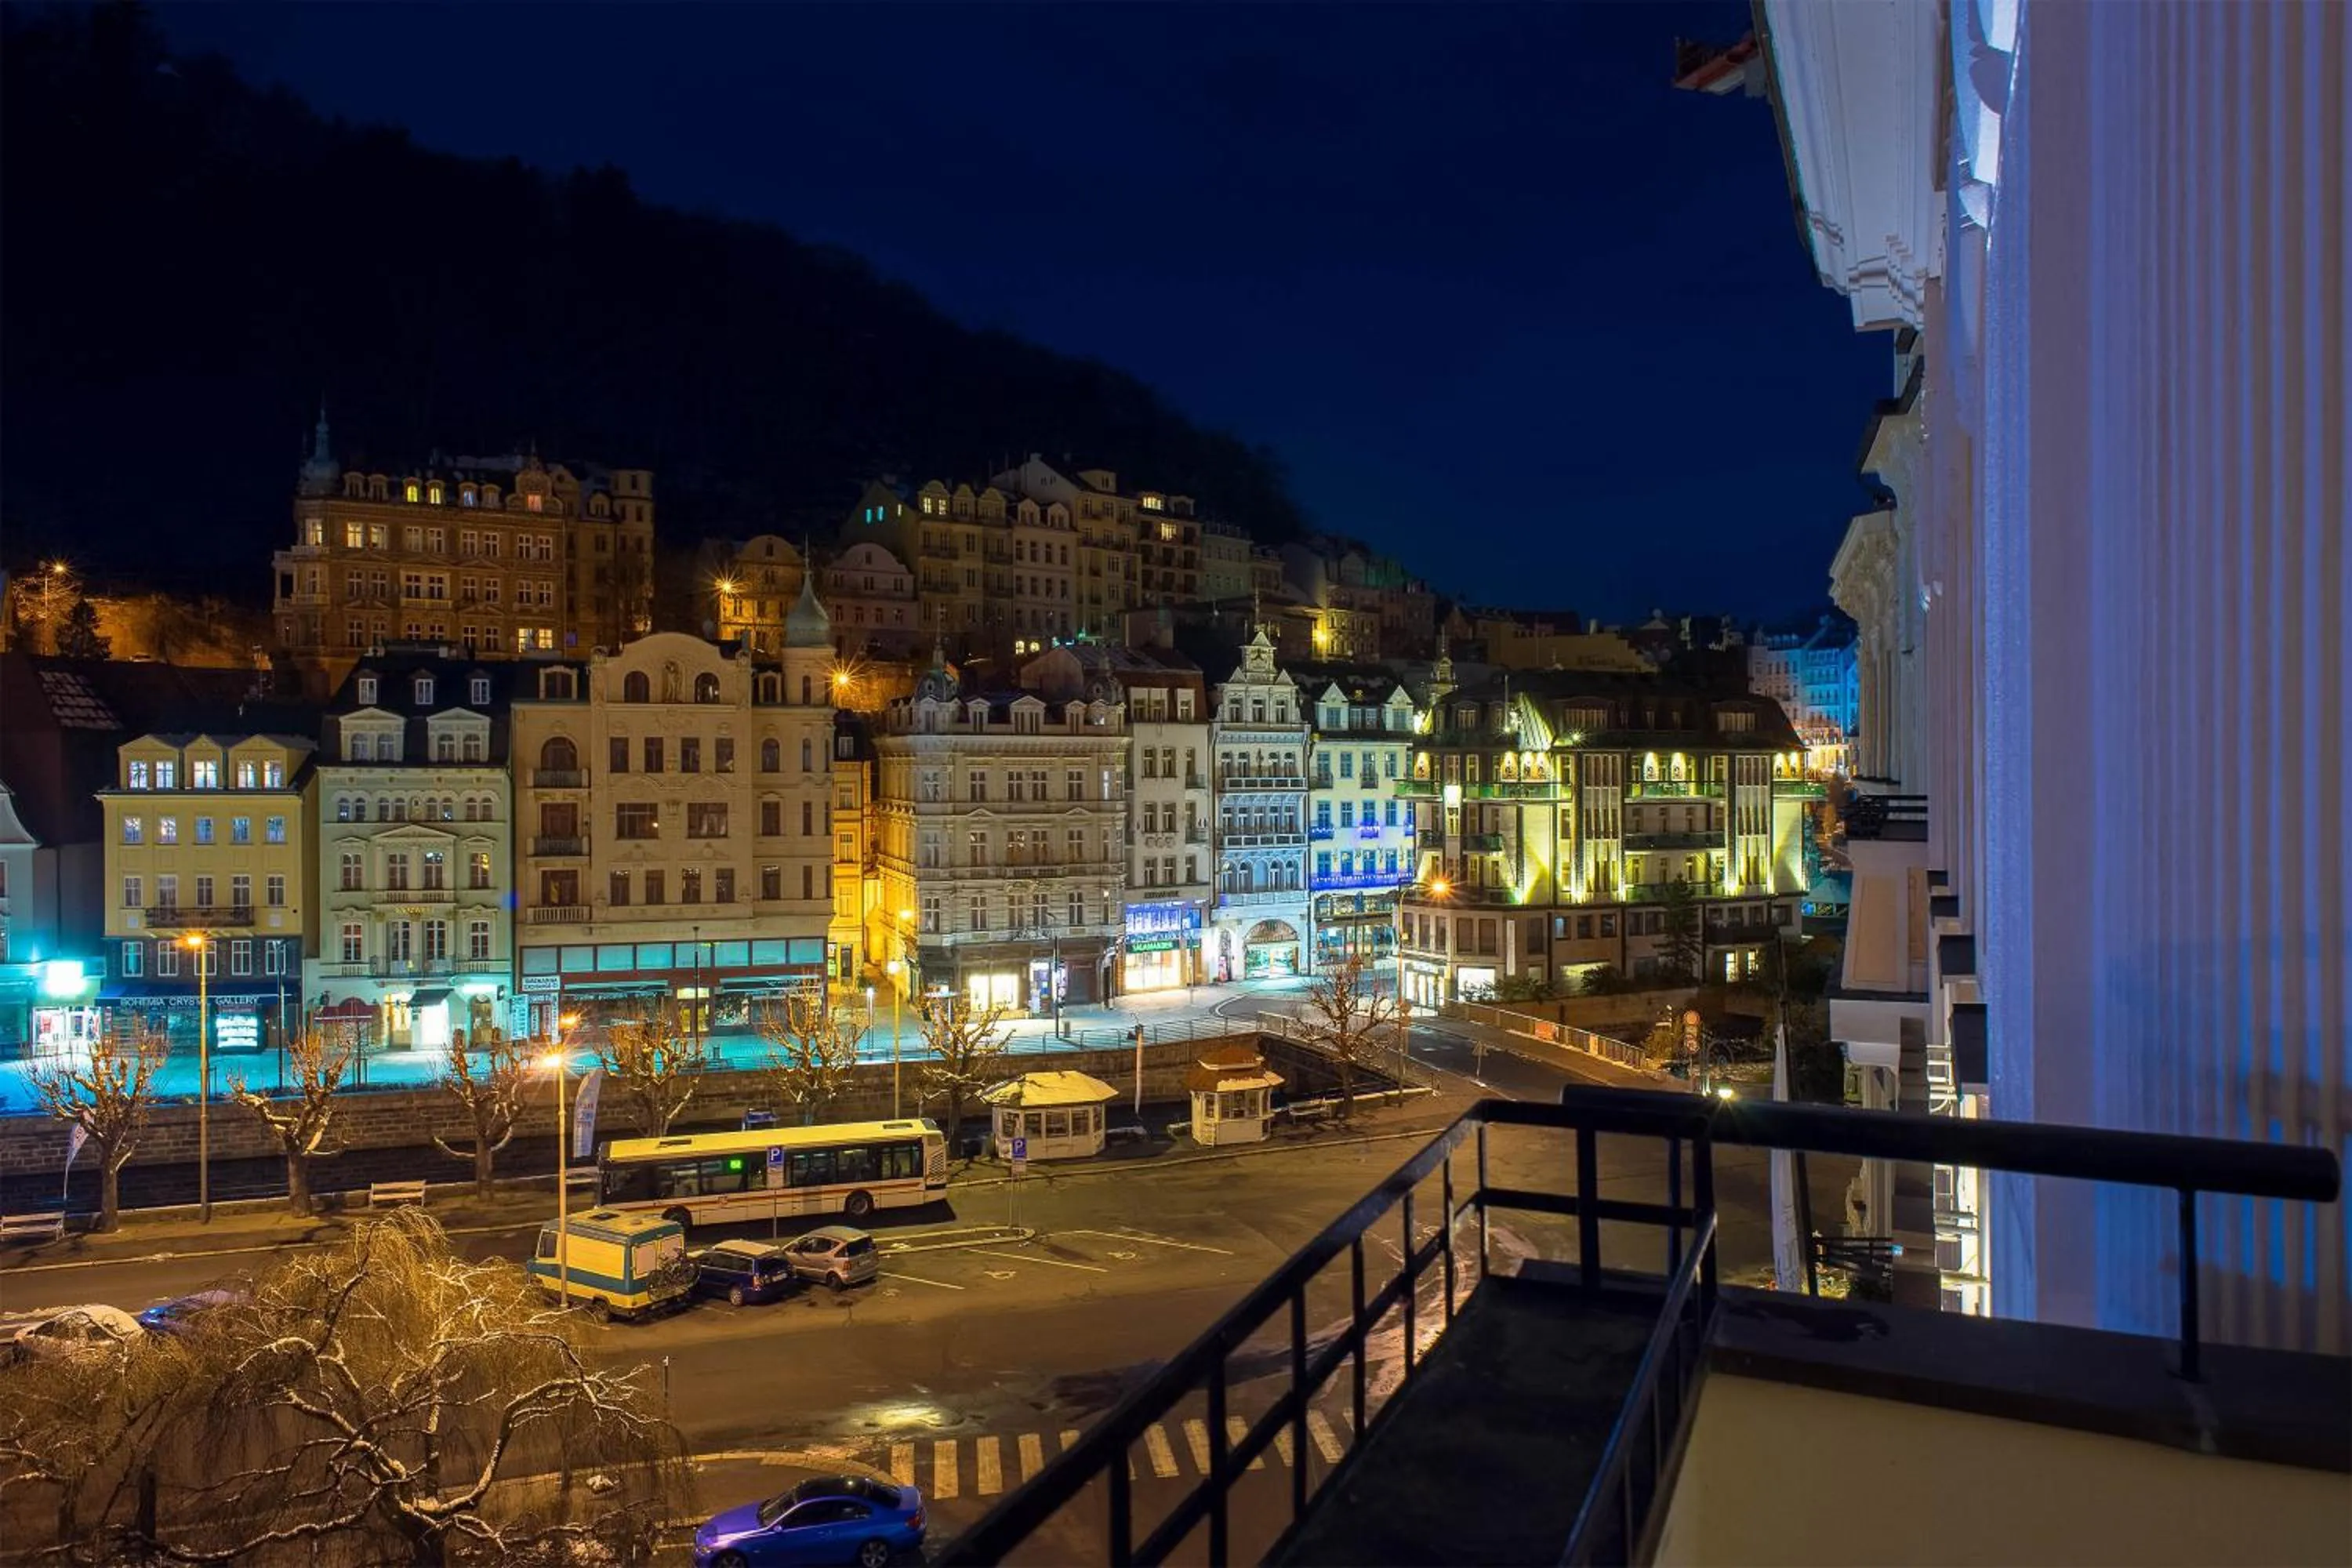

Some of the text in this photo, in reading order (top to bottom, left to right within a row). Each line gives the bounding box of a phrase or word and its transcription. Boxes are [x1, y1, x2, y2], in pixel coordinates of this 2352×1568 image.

[169, 996, 207, 1006] CRYS
[216, 995, 259, 1004] GALLERY
[1014, 1140, 1022, 1152] P
[771, 1149, 780, 1160] P
